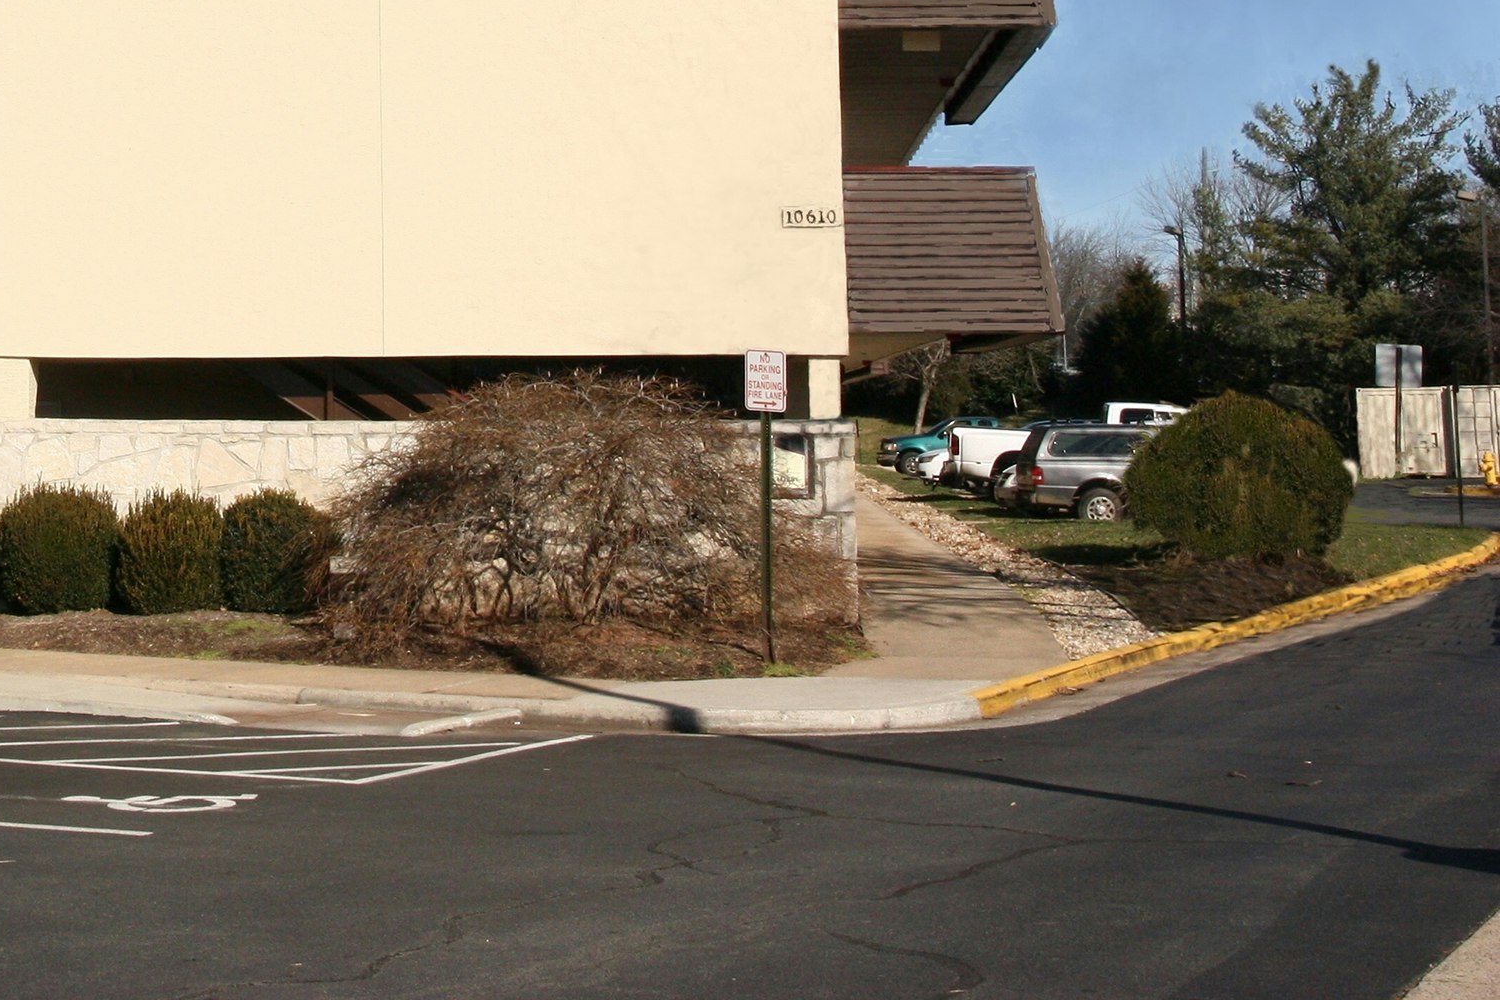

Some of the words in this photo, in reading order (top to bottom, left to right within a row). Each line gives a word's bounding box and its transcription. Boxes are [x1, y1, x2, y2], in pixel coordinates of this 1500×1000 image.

[786, 209, 836, 224] 10610
[759, 354, 771, 363] NO
[749, 364, 781, 374] PARKING
[748, 380, 782, 390] STANDING
[748, 390, 762, 398] FIRE
[765, 391, 782, 400] LANE
